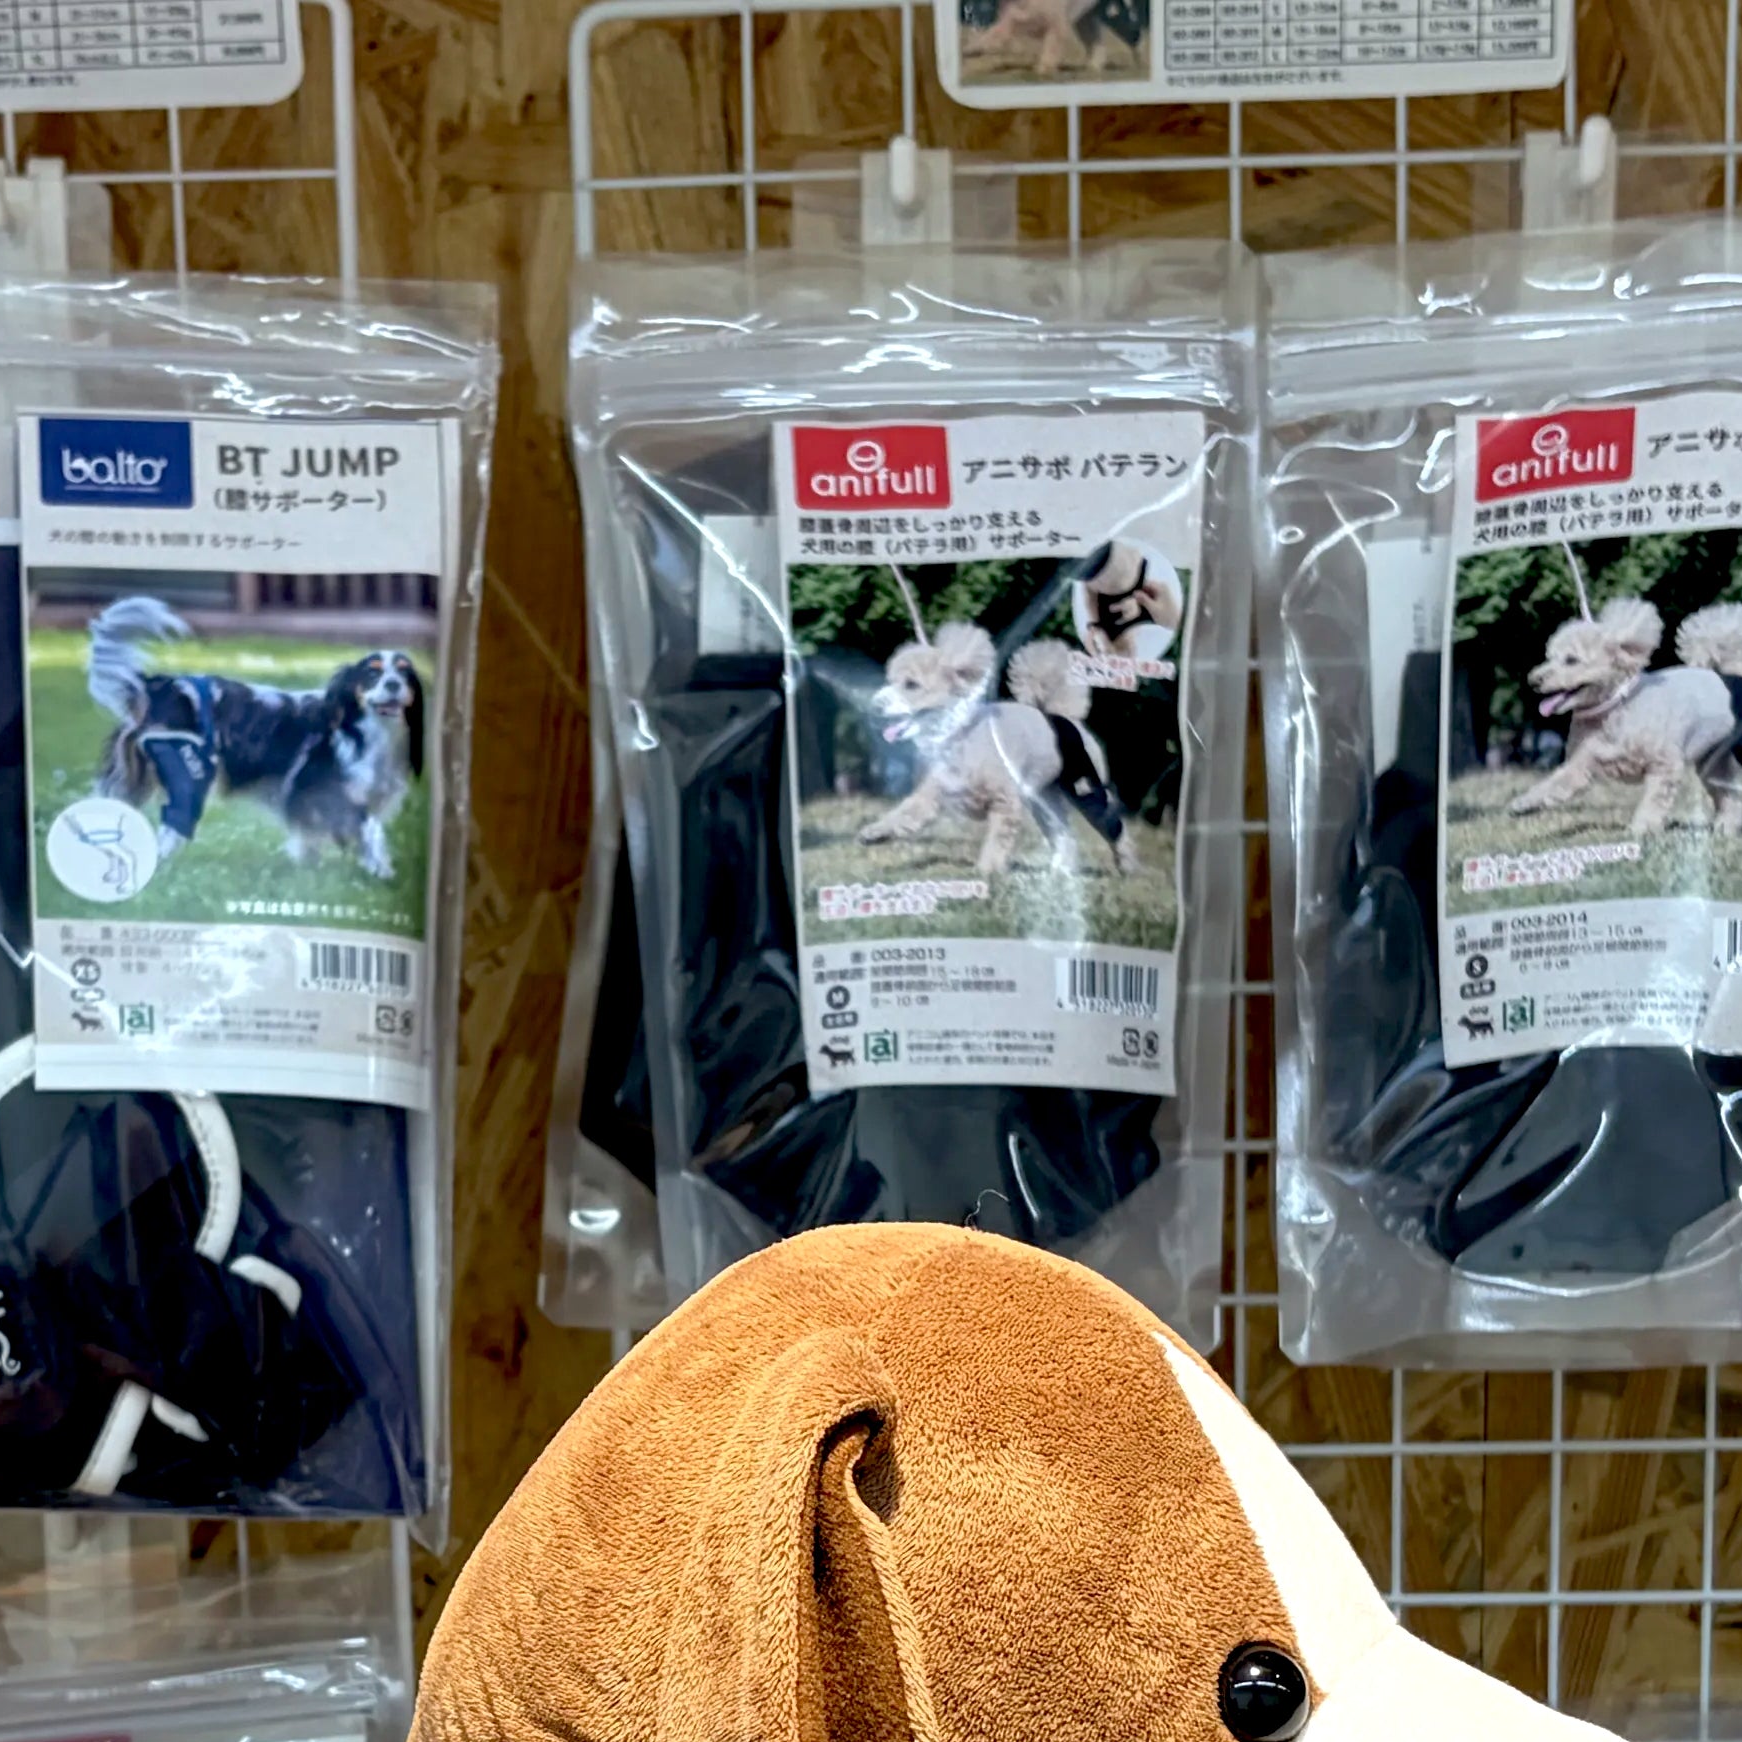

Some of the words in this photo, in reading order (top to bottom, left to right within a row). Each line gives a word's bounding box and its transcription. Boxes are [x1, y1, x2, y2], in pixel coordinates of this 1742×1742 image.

[60, 445, 168, 486] balto
[217, 445, 271, 478] BT
[281, 446, 401, 479] JUMP
[961, 455, 1073, 485] アニサポ
[1491, 442, 1619, 488] anifull
[810, 464, 937, 498] anifull
